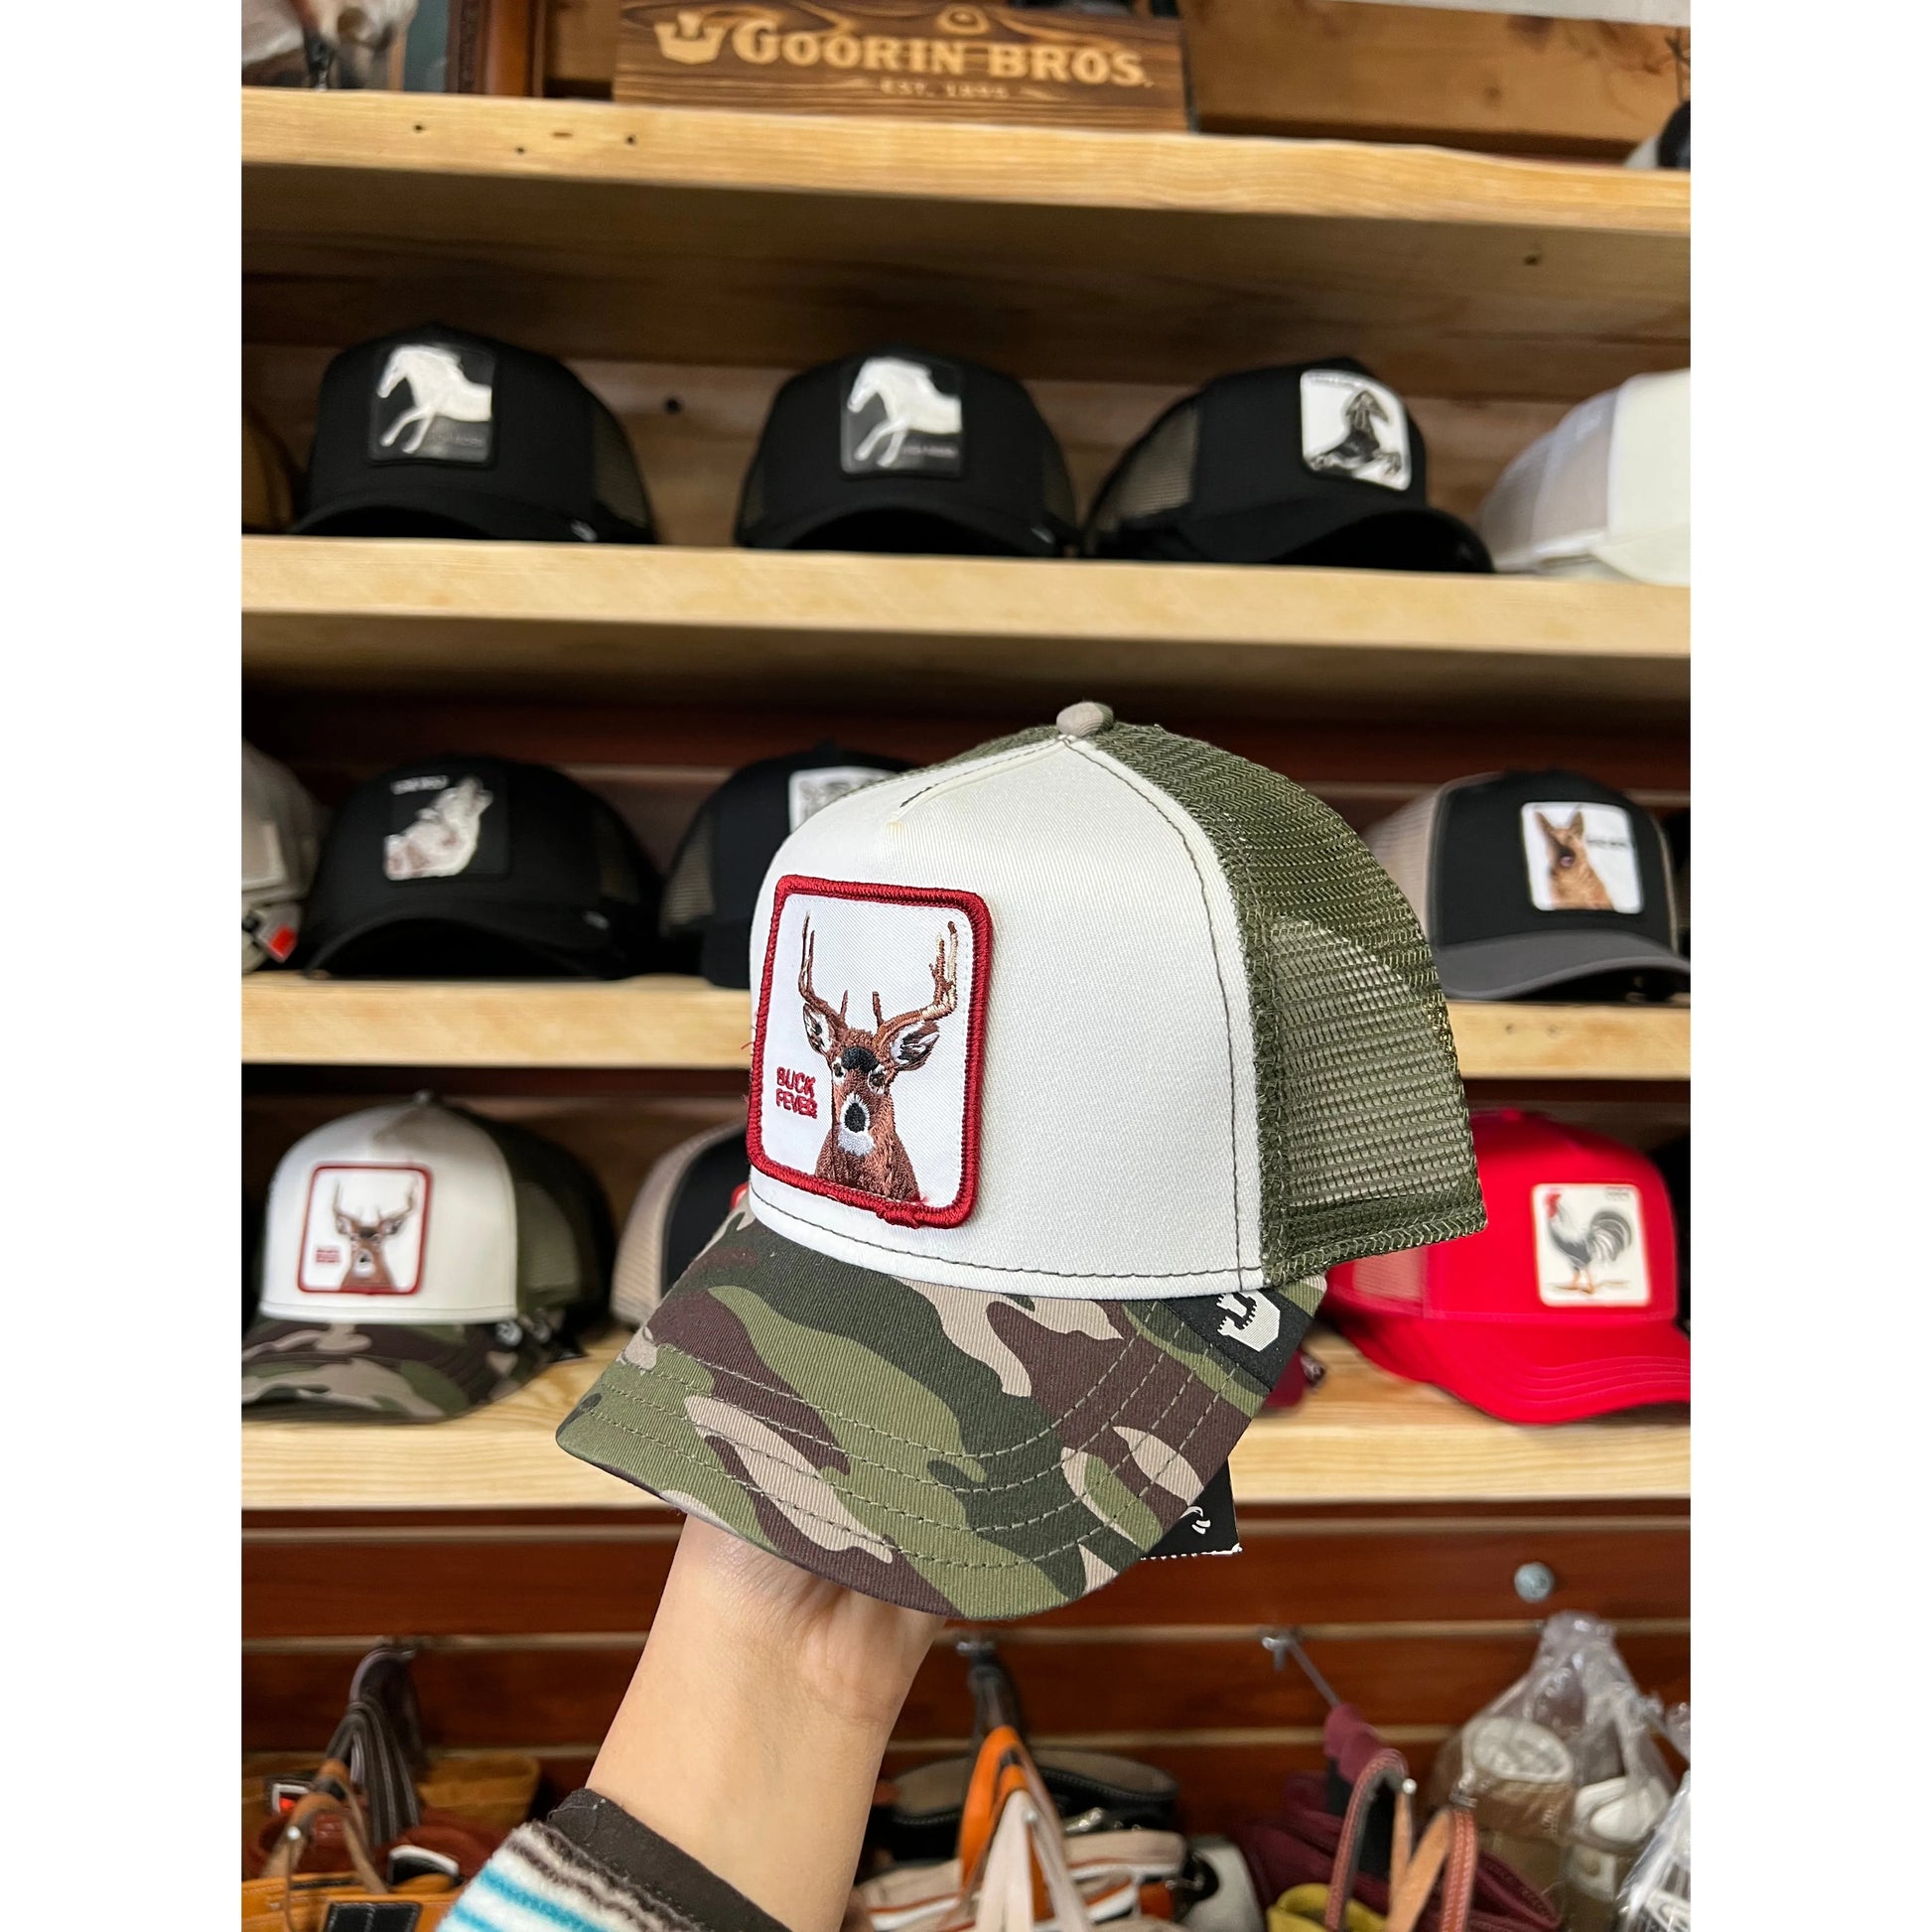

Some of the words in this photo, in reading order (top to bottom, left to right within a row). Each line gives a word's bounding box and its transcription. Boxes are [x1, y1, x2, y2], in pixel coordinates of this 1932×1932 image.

[732, 20, 965, 75] GOORIN
[776, 1066, 816, 1098] BUCK
[775, 1088, 818, 1119] FEVER
